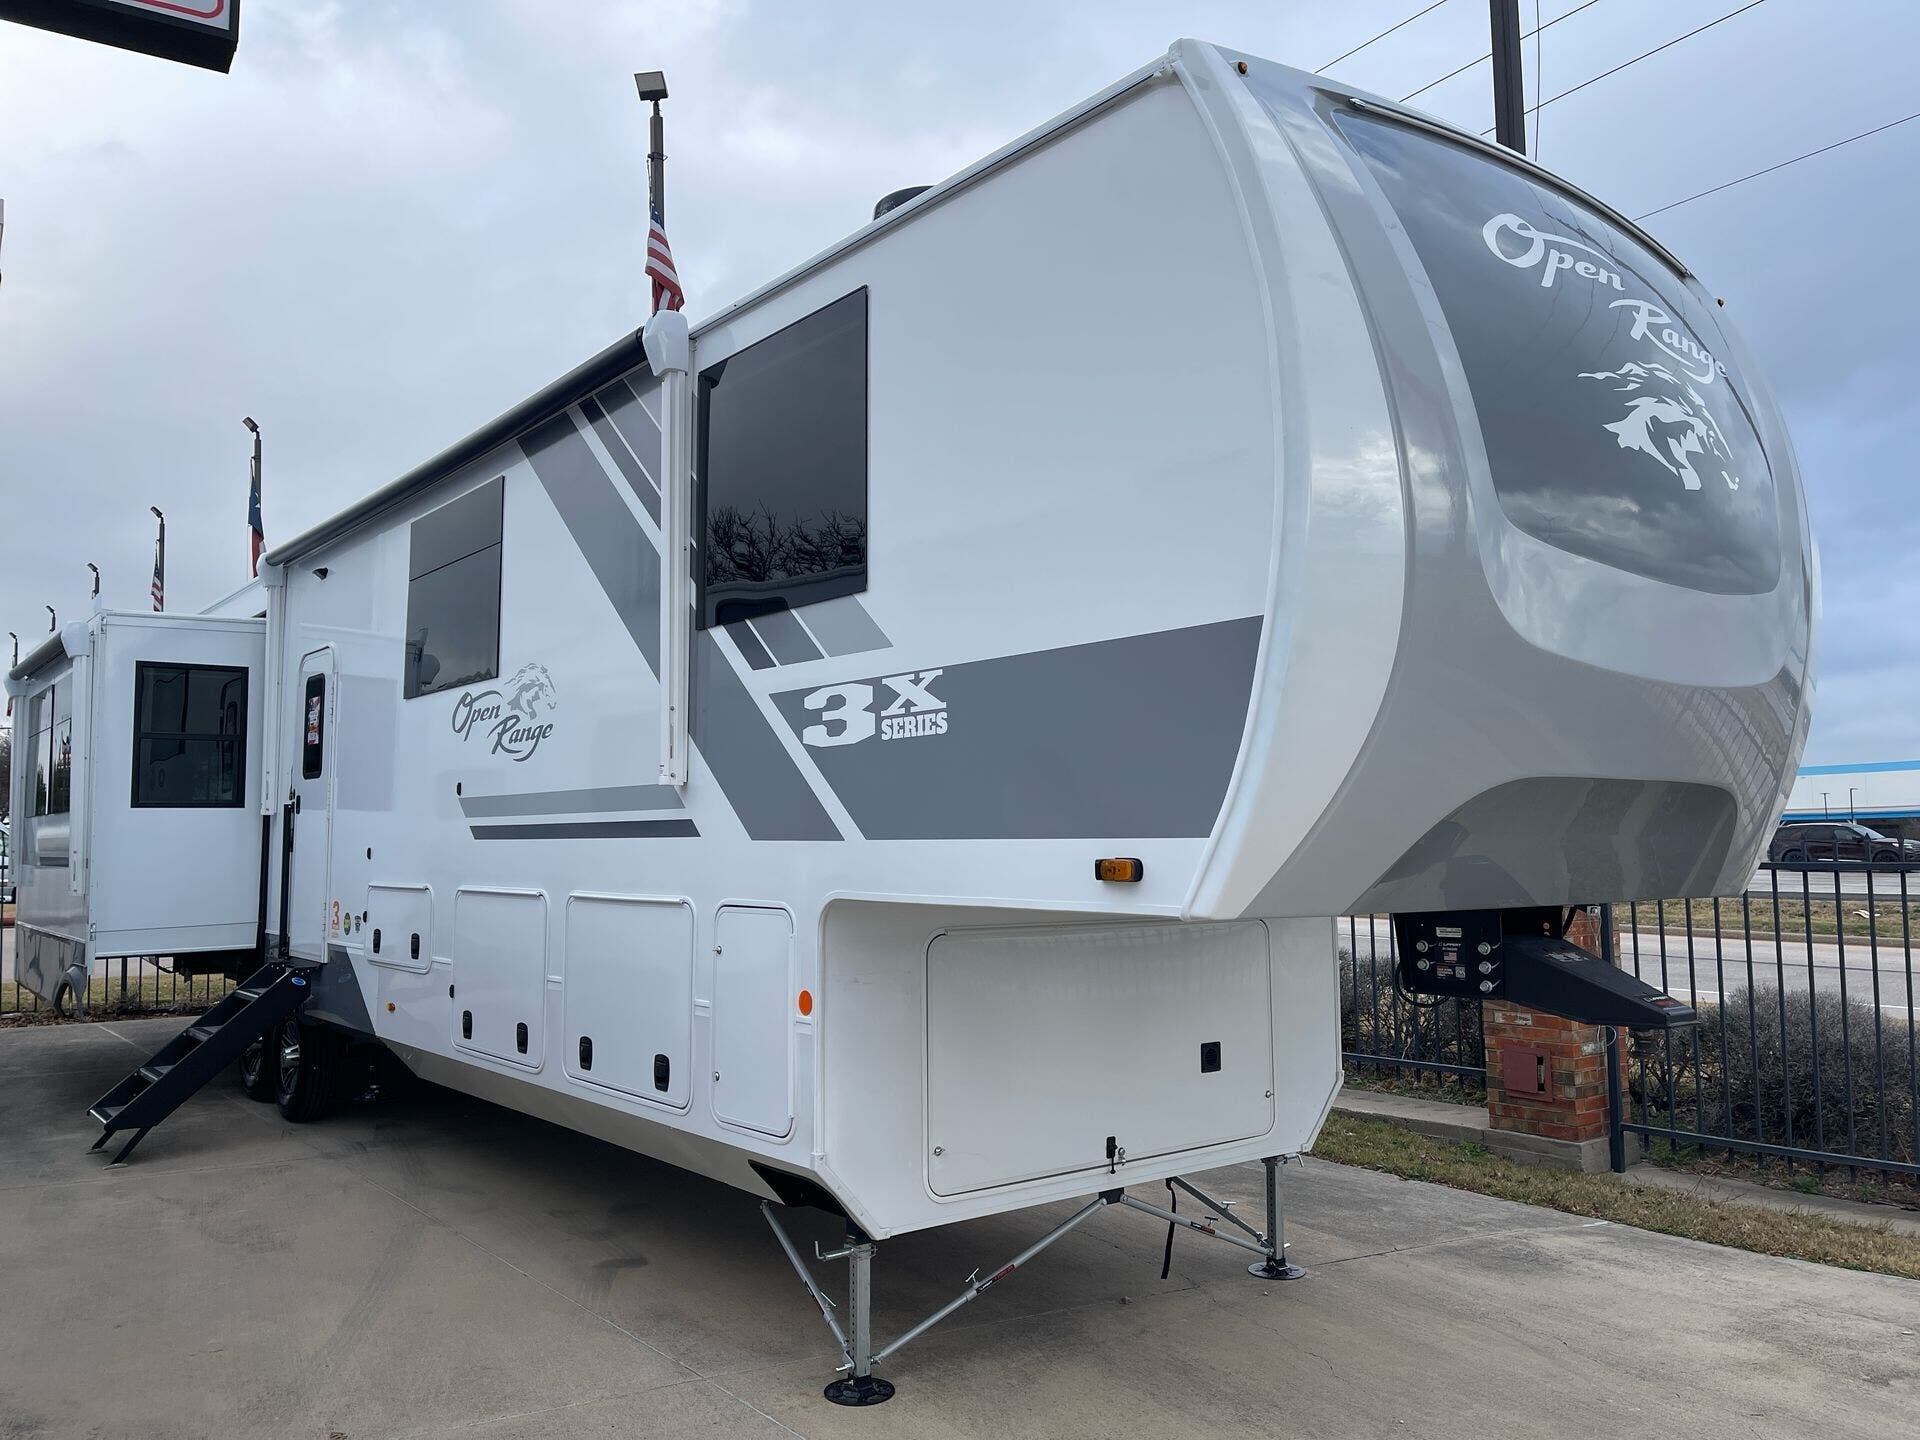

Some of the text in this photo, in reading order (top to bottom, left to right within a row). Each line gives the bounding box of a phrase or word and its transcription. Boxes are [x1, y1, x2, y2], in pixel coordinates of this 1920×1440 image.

[1482, 213, 1626, 290] Open
[1608, 299, 1728, 385] Range
[452, 690, 503, 742] Open
[487, 714, 554, 762] Range
[881, 711, 949, 741] SERIES
